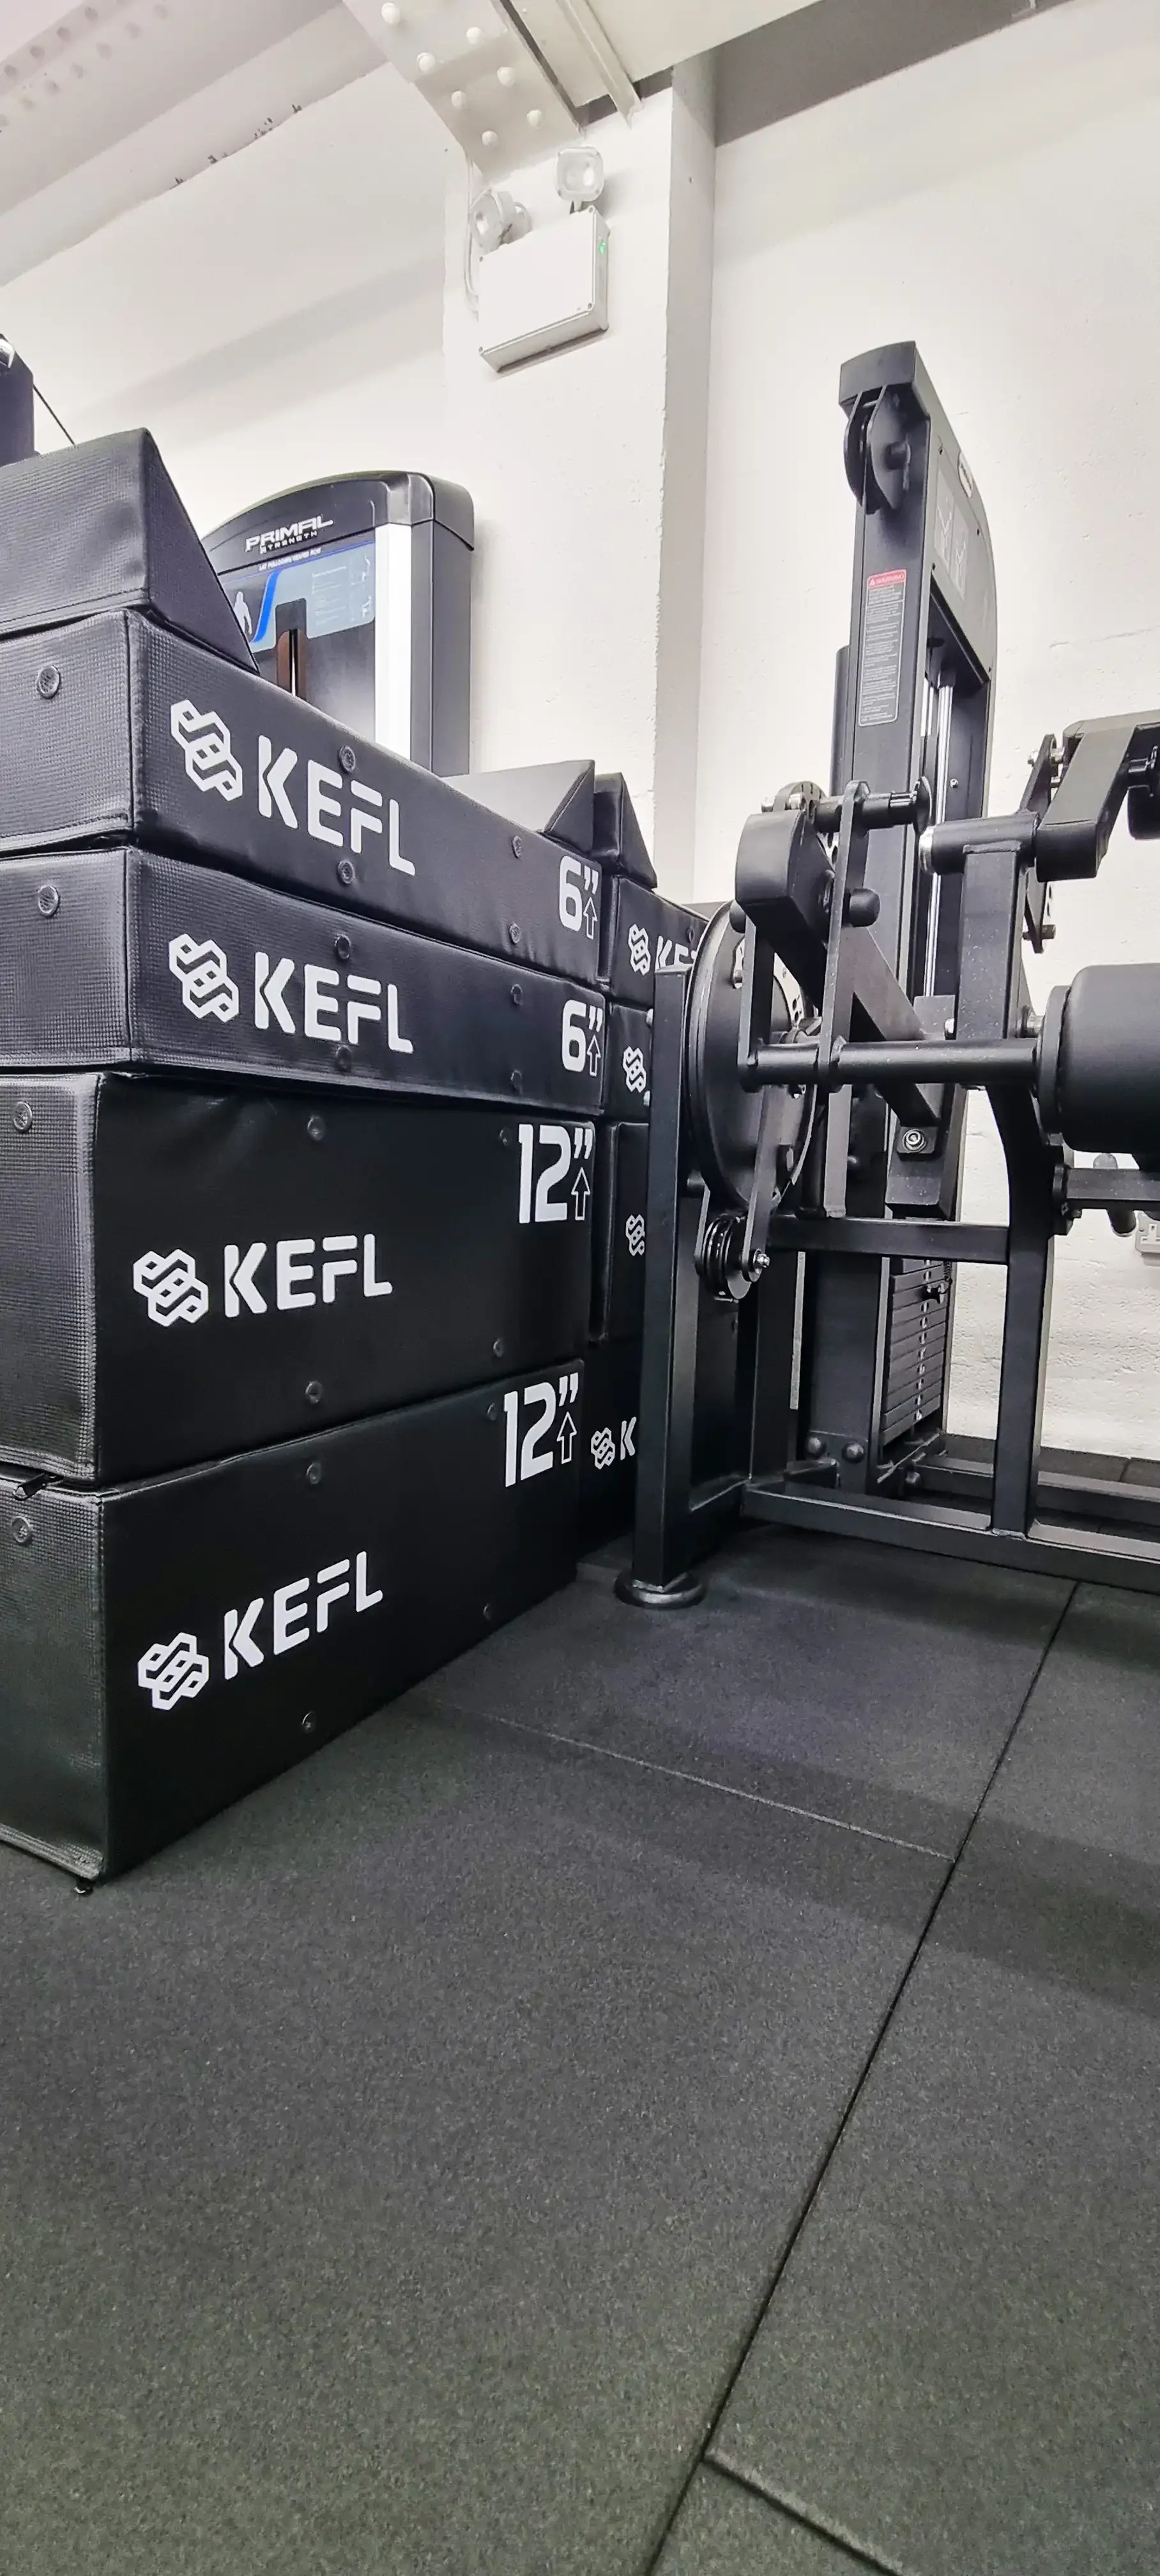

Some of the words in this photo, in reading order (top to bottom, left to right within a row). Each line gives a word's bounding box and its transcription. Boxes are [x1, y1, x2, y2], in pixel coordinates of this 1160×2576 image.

[245, 515, 333, 553] PRIMAL
[258, 735, 416, 877] KEFL
[254, 951, 413, 1054] KEFL
[224, 1234, 393, 1317] KEFL
[224, 1551, 383, 1680] KEFL
